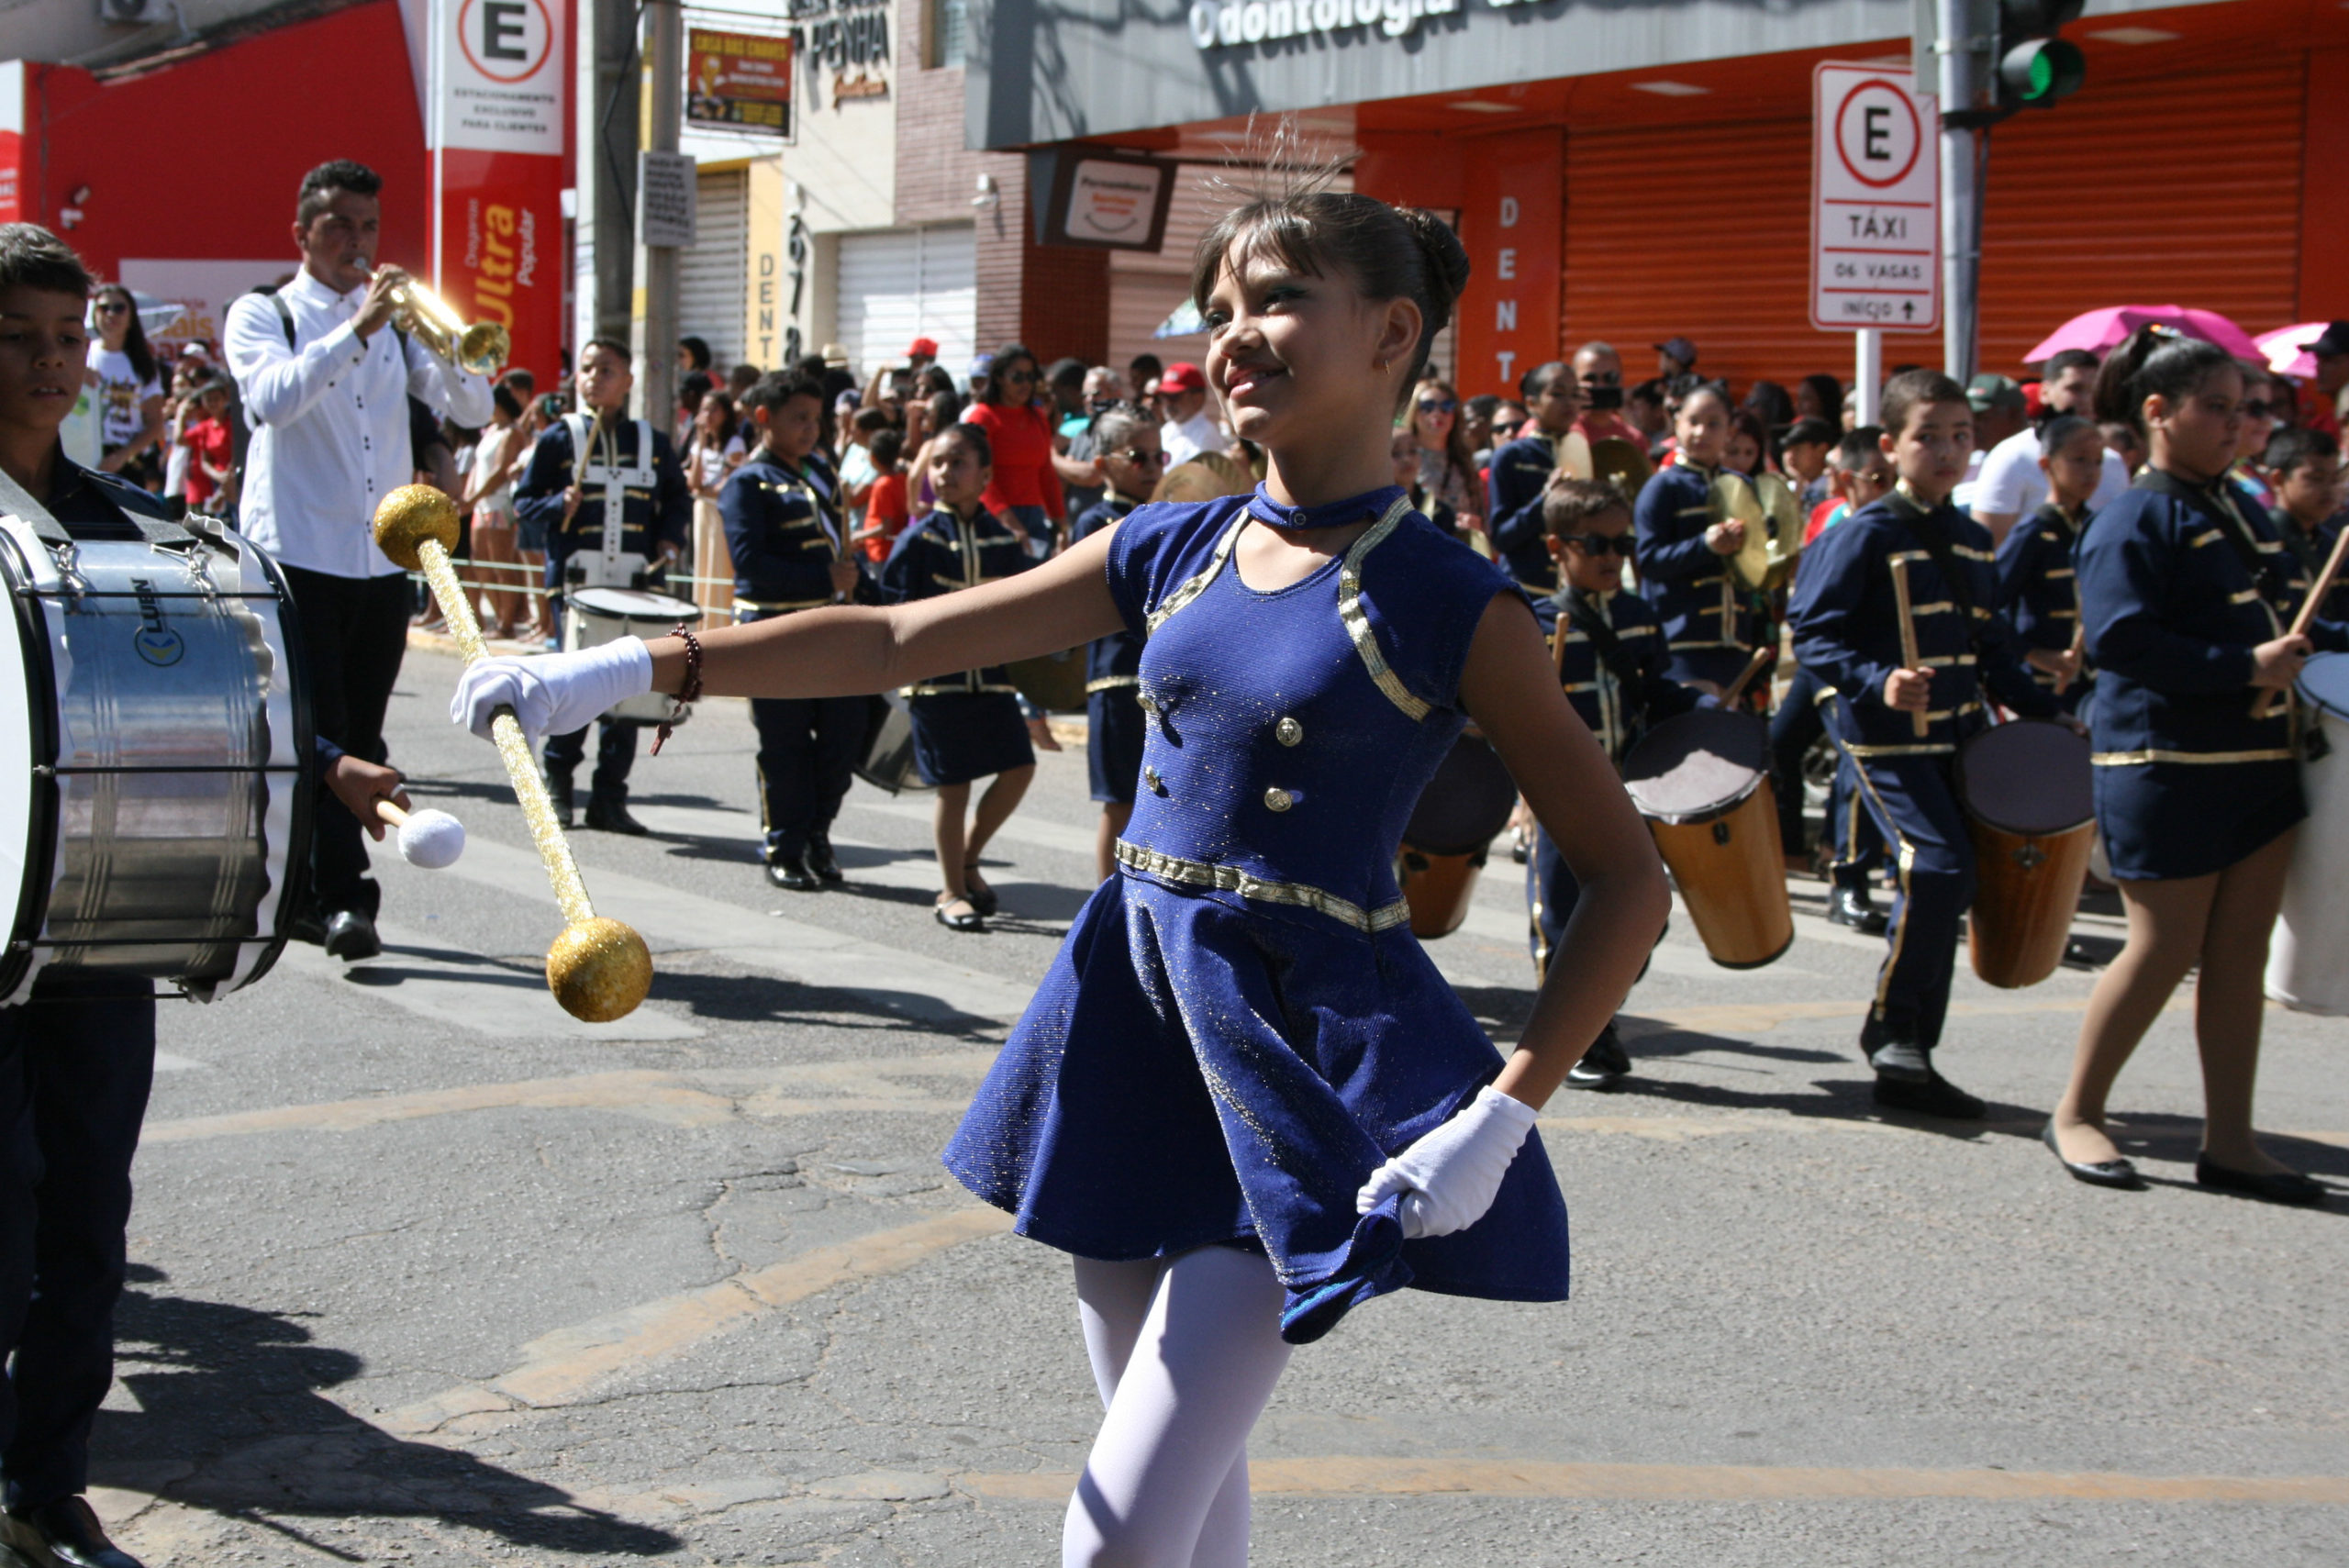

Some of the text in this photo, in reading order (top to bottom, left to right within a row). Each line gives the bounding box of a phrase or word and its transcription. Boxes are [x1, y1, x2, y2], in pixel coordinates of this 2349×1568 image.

[484, 2, 527, 61] E
[811, 10, 890, 72] PENHA
[1190, 0, 1457, 49] Odontologia
[1865, 106, 1891, 161] E
[517, 207, 537, 287] Popular
[1849, 207, 1907, 239] TÁXI
[475, 204, 514, 331] Ultra
[1866, 263, 1921, 279] VAGAS
[759, 254, 774, 372] DENT
